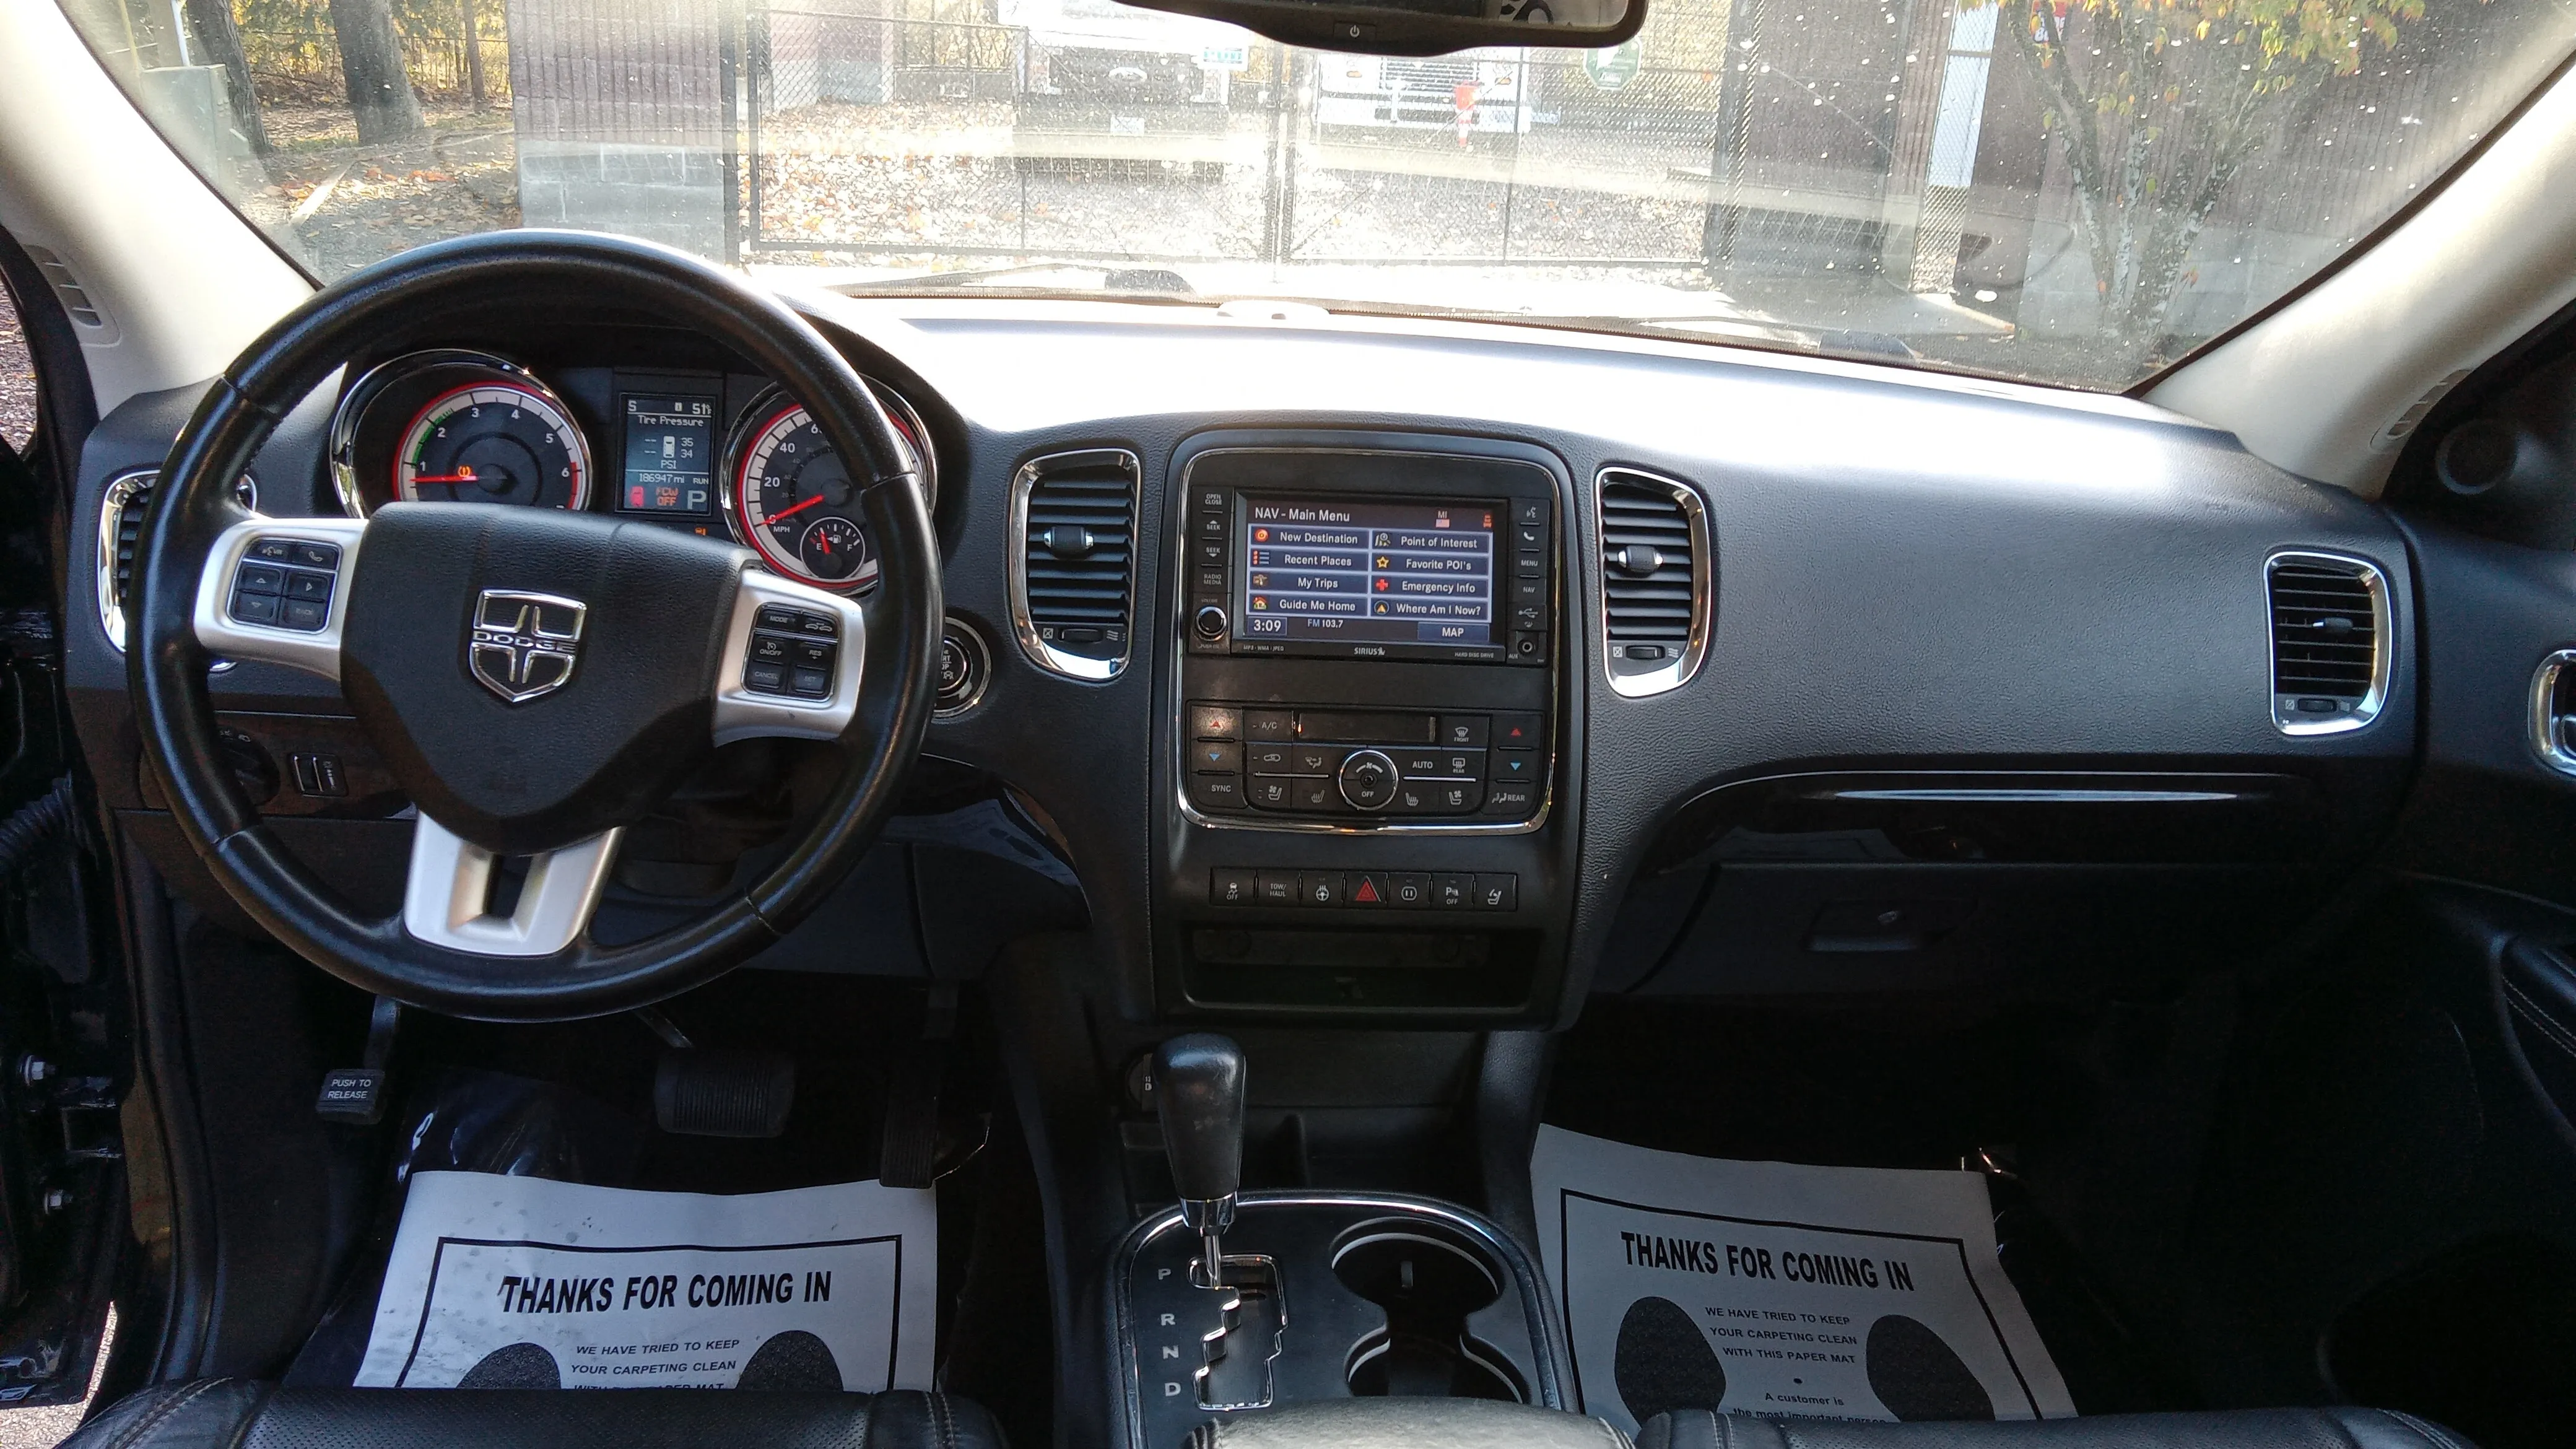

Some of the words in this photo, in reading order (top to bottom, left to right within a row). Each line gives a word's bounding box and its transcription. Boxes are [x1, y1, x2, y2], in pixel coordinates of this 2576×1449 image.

[471, 407, 479, 418] 3
[511, 409, 520, 419] 4
[638, 415, 656, 425] Tire
[659, 416, 704, 427] Pressure
[437, 427, 446, 438] 2
[811, 423, 823, 434] 6
[546, 433, 554, 443] 5
[680, 437, 694, 446] 35
[680, 449, 693, 458] 34
[779, 442, 796, 453] 40
[419, 461, 426, 471] 1
[660, 460, 677, 469] PSI
[561, 468, 570, 477] 6
[764, 477, 780, 487] 20
[656, 496, 676, 506] OFF
[687, 490, 707, 510] P
[1255, 507, 1279, 519] NAV
[1289, 508, 1315, 521] Main
[1319, 509, 1350, 523] Menu
[1280, 531, 1301, 542] New
[1304, 533, 1358, 544] Destination
[1401, 536, 1425, 547] Point
[1428, 536, 1437, 547] of
[1440, 537, 1477, 548] Interest
[1284, 554, 1318, 565] Recent
[1321, 555, 1352, 567] Places
[1406, 559, 1443, 570] Favorite
[1446, 560, 1471, 570] POI's
[1298, 577, 1312, 590] My
[1315, 577, 1338, 590] Trips
[1402, 581, 1453, 594] Emergency
[1456, 583, 1476, 593] Info
[1279, 599, 1307, 610] Guide
[1310, 600, 1325, 611] Me
[1328, 601, 1355, 611] Home
[1396, 603, 1427, 614] Where
[1429, 604, 1446, 614] Am
[1448, 604, 1452, 614] I
[1455, 605, 1481, 616] Now?
[1253, 619, 1282, 632] 3:09
[1307, 619, 1320, 627] FM
[1322, 619, 1343, 628] 103.7
[1442, 627, 1464, 637] MAP
[472, 630, 578, 653] DODGE
[1261, 721, 1277, 730] A/C
[1412, 760, 1434, 769] AUTO
[1211, 785, 1231, 793] SYNC
[1507, 794, 1525, 802] REAR
[331, 1079, 357, 1087] PUSH
[359, 1079, 372, 1087] TO
[328, 1090, 368, 1099] RELEASE
[1621, 1231, 1718, 1275] THANKS
[1726, 1244, 1776, 1280] FOR
[1782, 1251, 1879, 1289] COMING
[1884, 1260, 1915, 1292] IN
[1158, 1268, 1172, 1280] P
[500, 1275, 614, 1313] THANKS
[622, 1275, 677, 1311] FOR
[688, 1273, 793, 1309] COMING
[803, 1270, 832, 1303] IN
[1160, 1313, 1176, 1326] R
[1705, 1307, 1724, 1316] WE
[1728, 1308, 1759, 1319] HAVE
[1762, 1311, 1796, 1321] TRIED
[1800, 1313, 1816, 1323] TO
[1820, 1315, 1850, 1325] KEEP
[1710, 1327, 1743, 1338] YOUR
[1747, 1329, 1814, 1342] CARPETING
[1818, 1334, 1858, 1345] CLEAN
[576, 1346, 597, 1355] WE
[601, 1345, 637, 1355] HAVE
[642, 1343, 679, 1354] TRIED
[684, 1342, 701, 1351] TO
[705, 1339, 740, 1350] KEEP
[1162, 1345, 1179, 1359] N
[1723, 1347, 1753, 1357] WITH
[1756, 1349, 1783, 1359] THIS
[1787, 1351, 1827, 1362] PAPER
[1830, 1354, 1856, 1364] MAT
[571, 1364, 608, 1375] YOUR
[612, 1362, 688, 1375] CARPETING
[693, 1360, 737, 1372] CLEAN
[1164, 1382, 1181, 1396] D
[1765, 1393, 1774, 1401] A
[1777, 1394, 1830, 1406] customer
[1833, 1396, 1845, 1406] is
